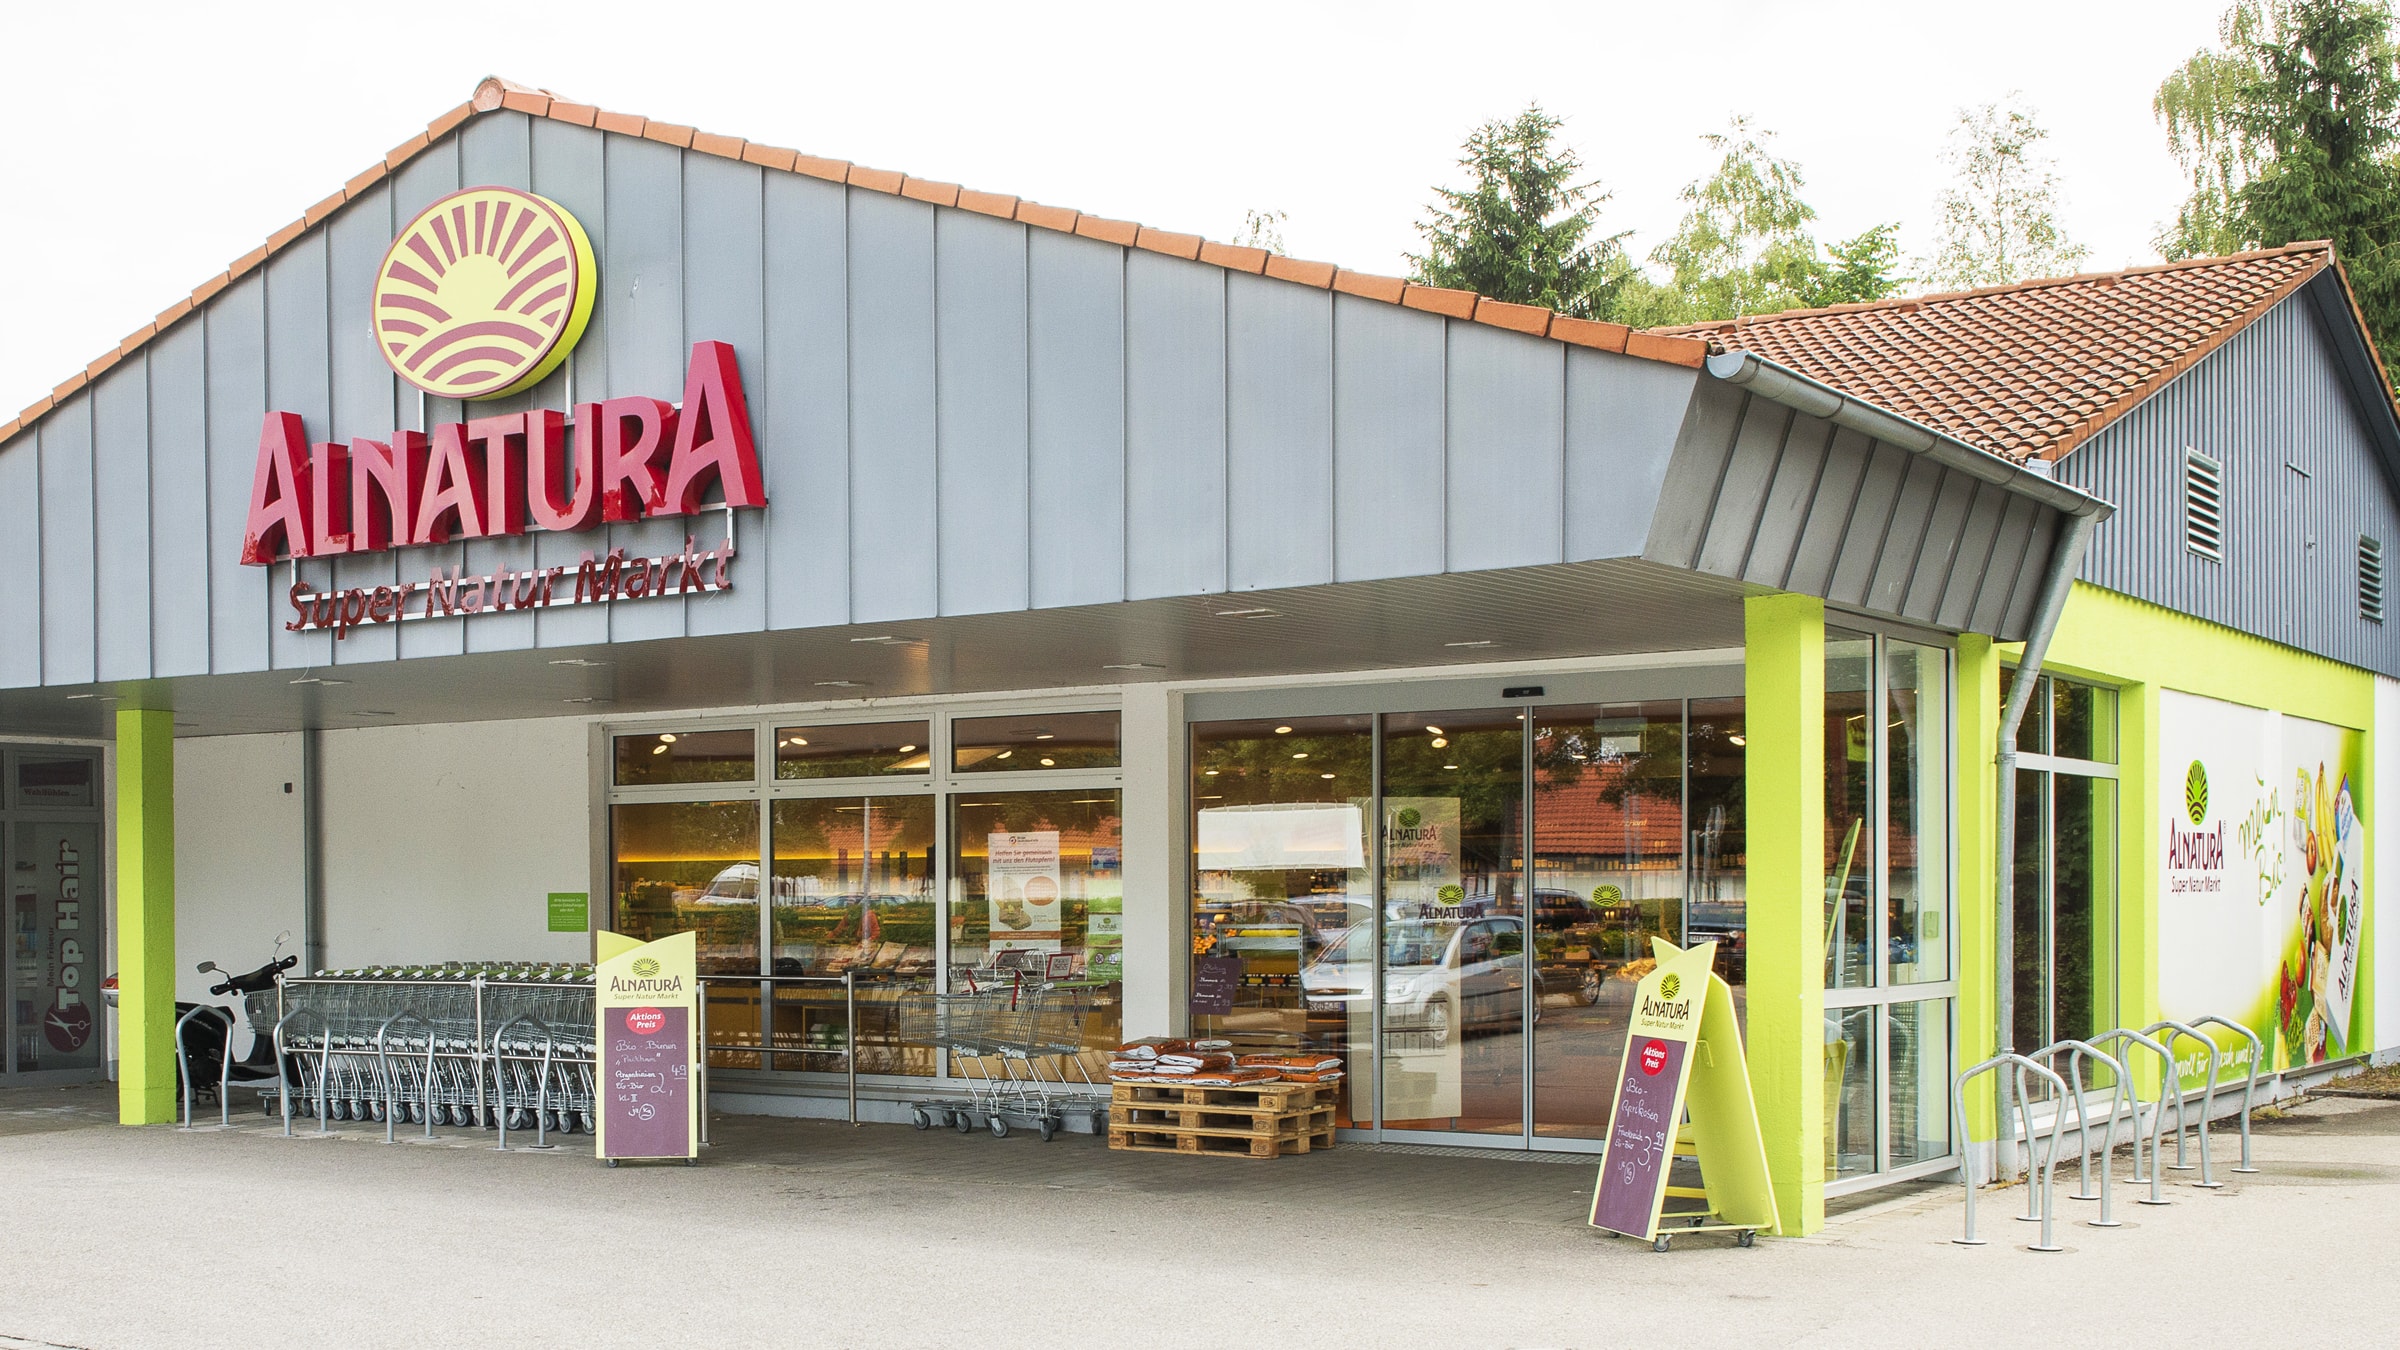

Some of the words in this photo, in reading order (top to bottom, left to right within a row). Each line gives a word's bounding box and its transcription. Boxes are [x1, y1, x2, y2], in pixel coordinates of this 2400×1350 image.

[240, 340, 768, 567] ALNATURA
[286, 580, 417, 641] Super
[426, 563, 564, 618] Natur
[574, 535, 735, 605] Markt
[1382, 825, 1437, 841] ALNATURA
[2168, 817, 2224, 871] ALNATURA
[55, 838, 81, 931] Hair
[1419, 904, 1484, 919] ALNATURA
[54, 938, 84, 1011] Top
[610, 975, 683, 992] ALNATURA
[614, 993, 635, 1001] Super
[657, 992, 679, 1000] Markt
[1641, 994, 1690, 1021] ALNATURA
[630, 1013, 662, 1021] Aktions
[636, 1021, 656, 1029] Preis
[1640, 1017, 1656, 1028] Super
[1655, 1020, 1669, 1029] Natur
[1669, 1021, 1684, 1030] Markt
[1643, 1046, 1666, 1059] Aktions
[1645, 1057, 1660, 1069] Preis
